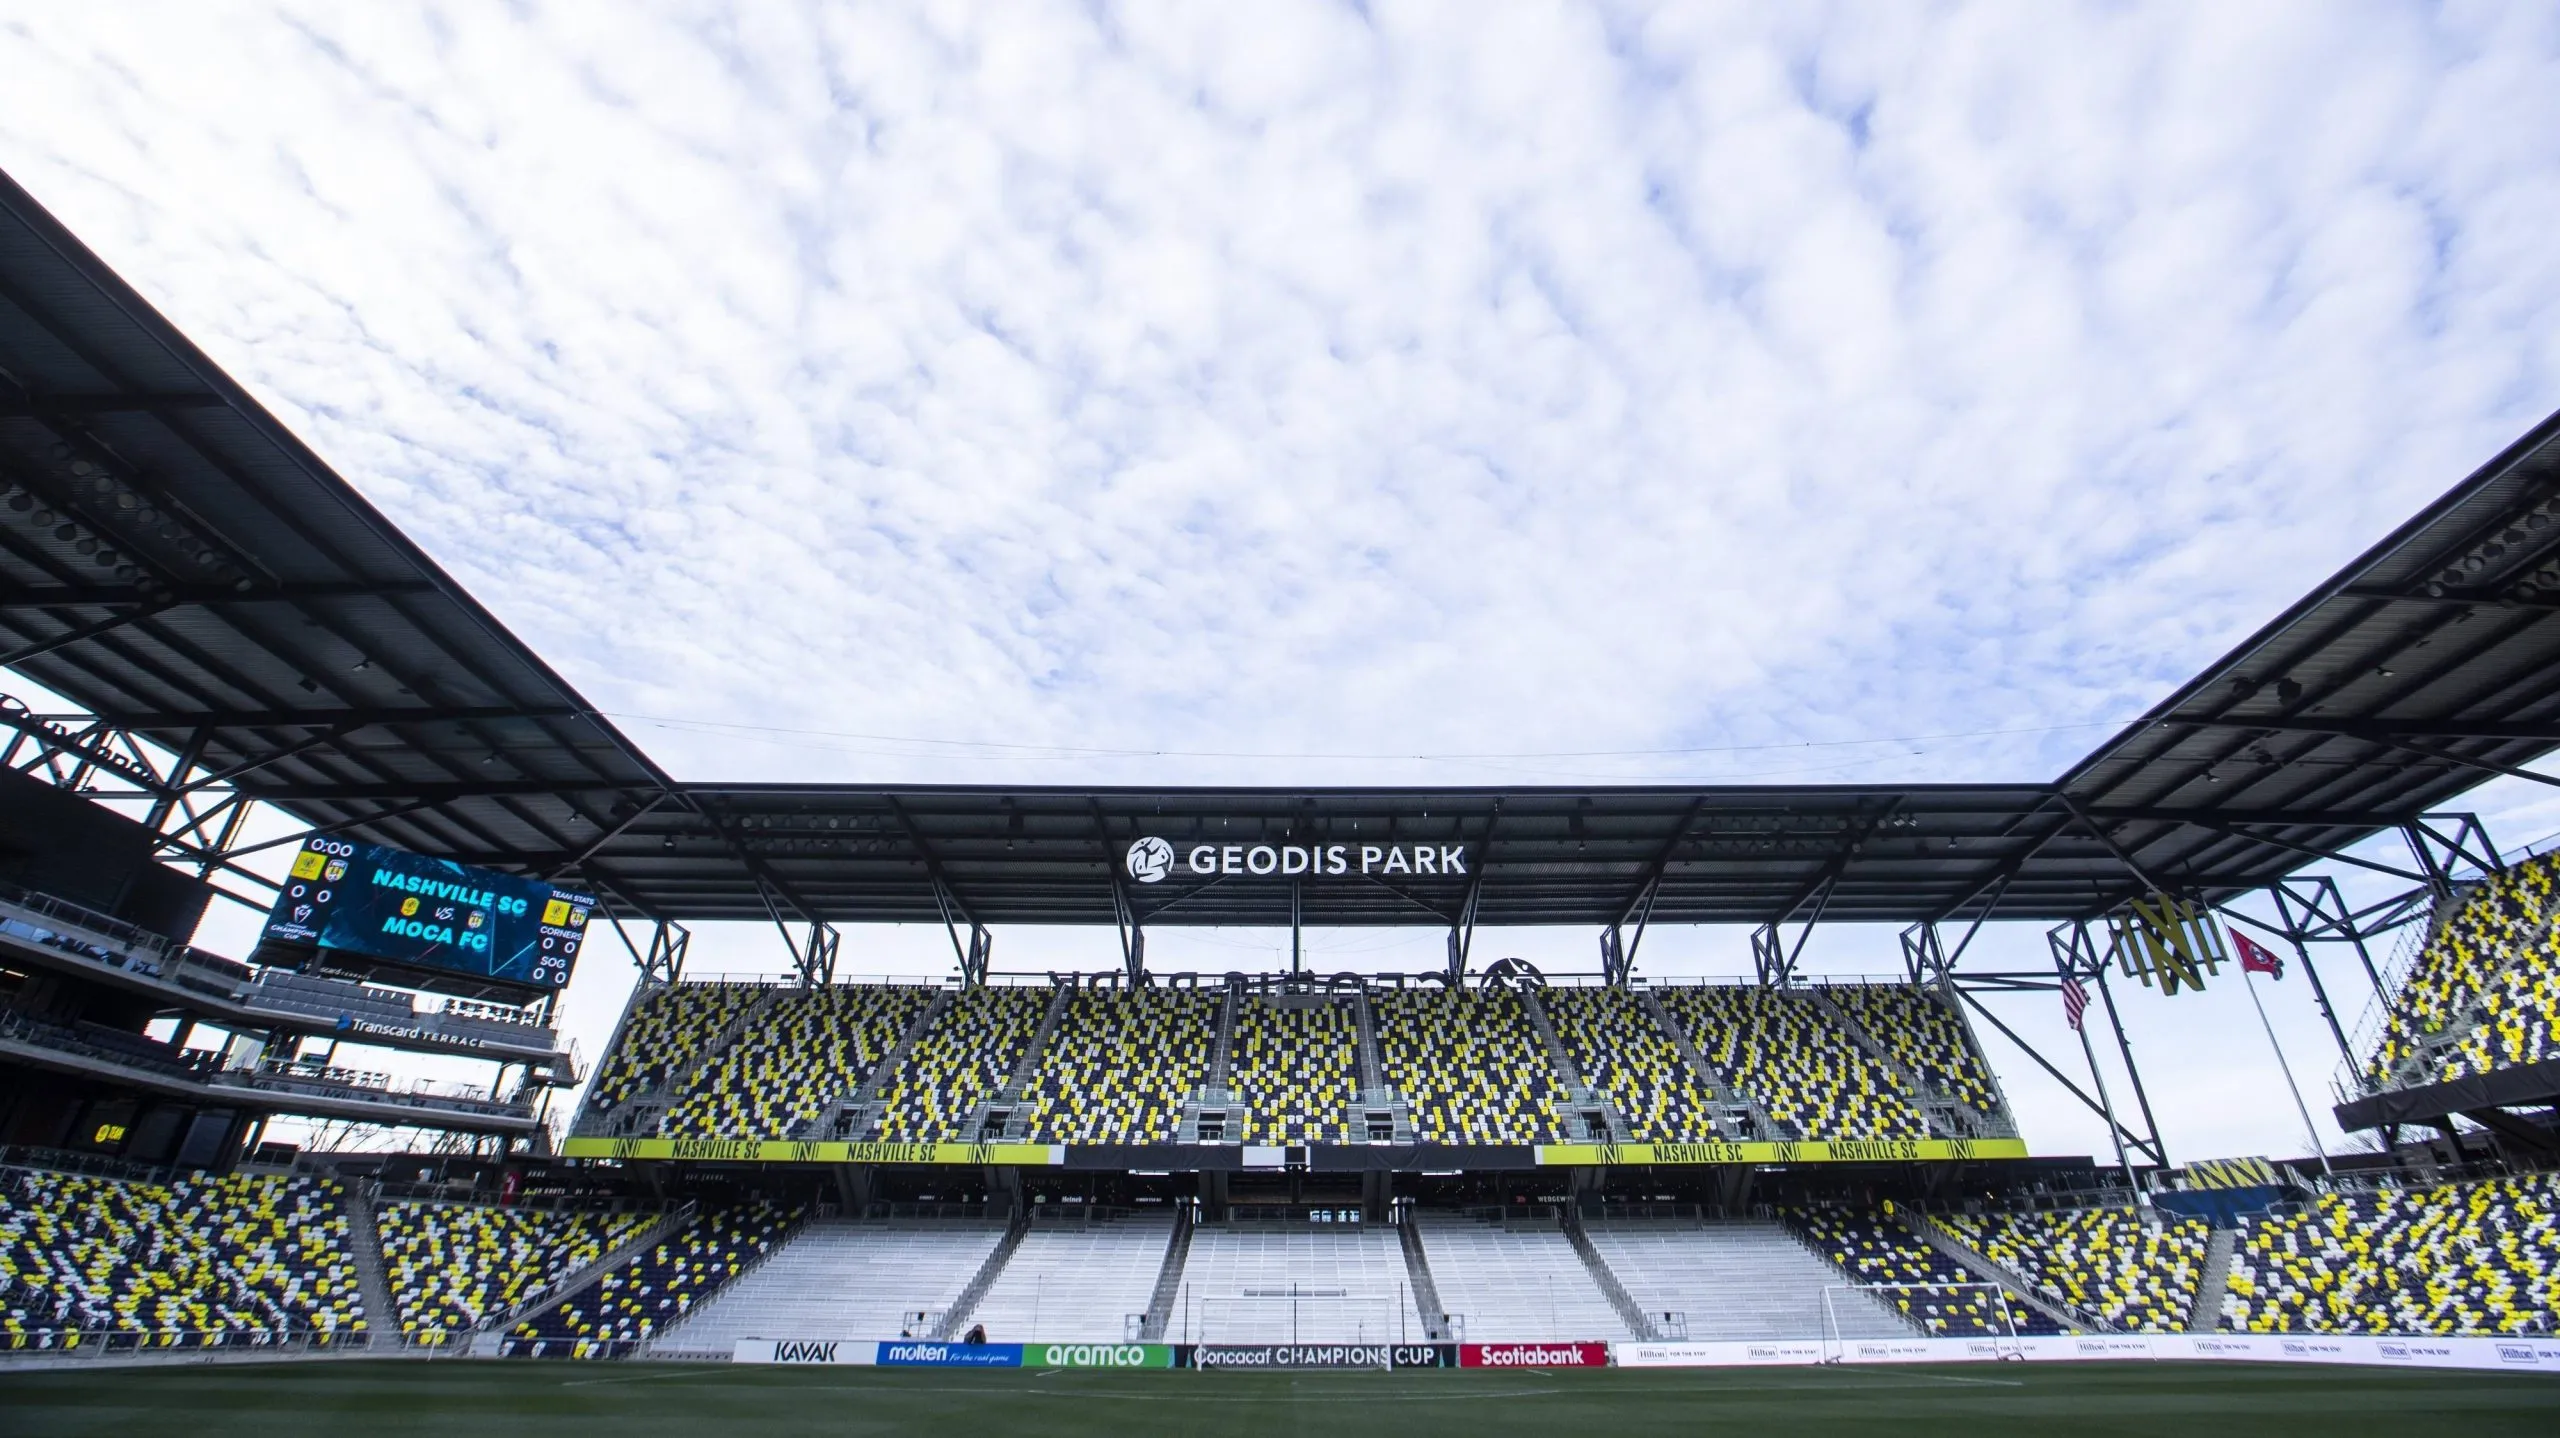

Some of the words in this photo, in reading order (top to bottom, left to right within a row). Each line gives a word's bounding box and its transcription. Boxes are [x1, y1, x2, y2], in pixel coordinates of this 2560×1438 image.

[311, 838, 353, 857] 0:00
[1189, 846, 1347, 875] GEODIS
[1362, 846, 1467, 874] PARK
[291, 885, 305, 898] 0
[317, 890, 331, 903] 0
[372, 869, 495, 907] NASHVILLE
[497, 896, 528, 915] SC
[552, 890, 574, 901] TEAM
[573, 895, 595, 905] STATS
[382, 917, 453, 944] MOCA
[458, 931, 488, 950] FC
[540, 926, 583, 941] CORNERS
[542, 937, 554, 949] 0
[564, 941, 576, 953] 0
[540, 956, 566, 969] SOG
[533, 967, 545, 980] 0
[555, 972, 566, 983] 0
[353, 1018, 420, 1039] Transcard
[422, 1031, 487, 1048] TERRACE
[672, 1140, 740, 1158] NASHVILLE
[743, 1141, 761, 1159] SC
[847, 1143, 915, 1161] NASHVILLE
[919, 1144, 936, 1161] SC
[1653, 1144, 1722, 1162] NASHVILLE
[1727, 1144, 1743, 1161] SC
[1828, 1142, 1897, 1160] NASHVILLE
[1900, 1142, 1918, 1159] SC
[774, 1341, 838, 1362] KAVAK
[889, 1344, 949, 1361] molten
[1046, 1345, 1144, 1366] aramco
[1481, 1345, 1584, 1367] Scotiabank
[1861, 1347, 1886, 1355] Hilton
[2079, 1343, 2105, 1351] Hilton
[2380, 1345, 2407, 1355] Hilton
[2500, 1348, 2534, 1358] Hilton
[1194, 1347, 1271, 1365] Concacaf
[1276, 1347, 1388, 1366] CHAMPIONS
[1395, 1348, 1434, 1366] CUP
